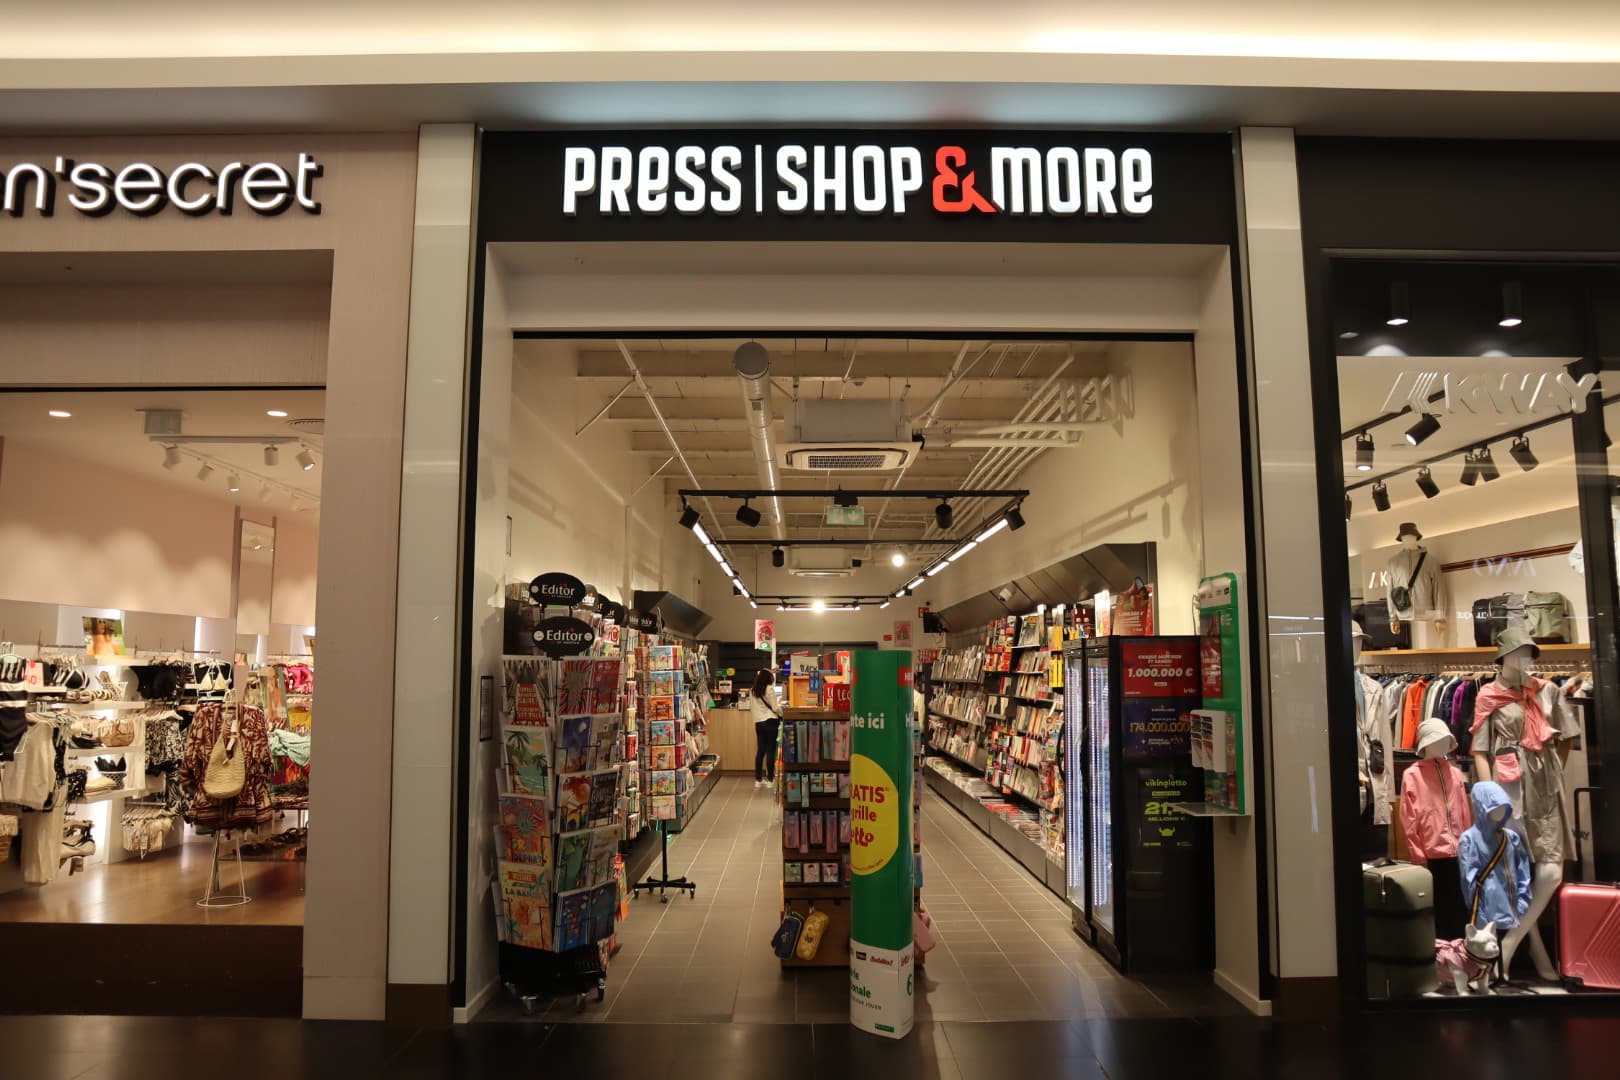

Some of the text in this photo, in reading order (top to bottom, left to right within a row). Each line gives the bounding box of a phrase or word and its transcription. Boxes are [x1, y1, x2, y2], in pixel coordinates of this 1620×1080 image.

[562, 145, 1154, 215] PRESS SHOP & MORE
[541, 584, 576, 596] Editor
[545, 629, 584, 641] Editor
[1127, 667, 1184, 678] 1.000.000
[867, 712, 886, 729] ici
[1145, 777, 1188, 788] vikinglotto
